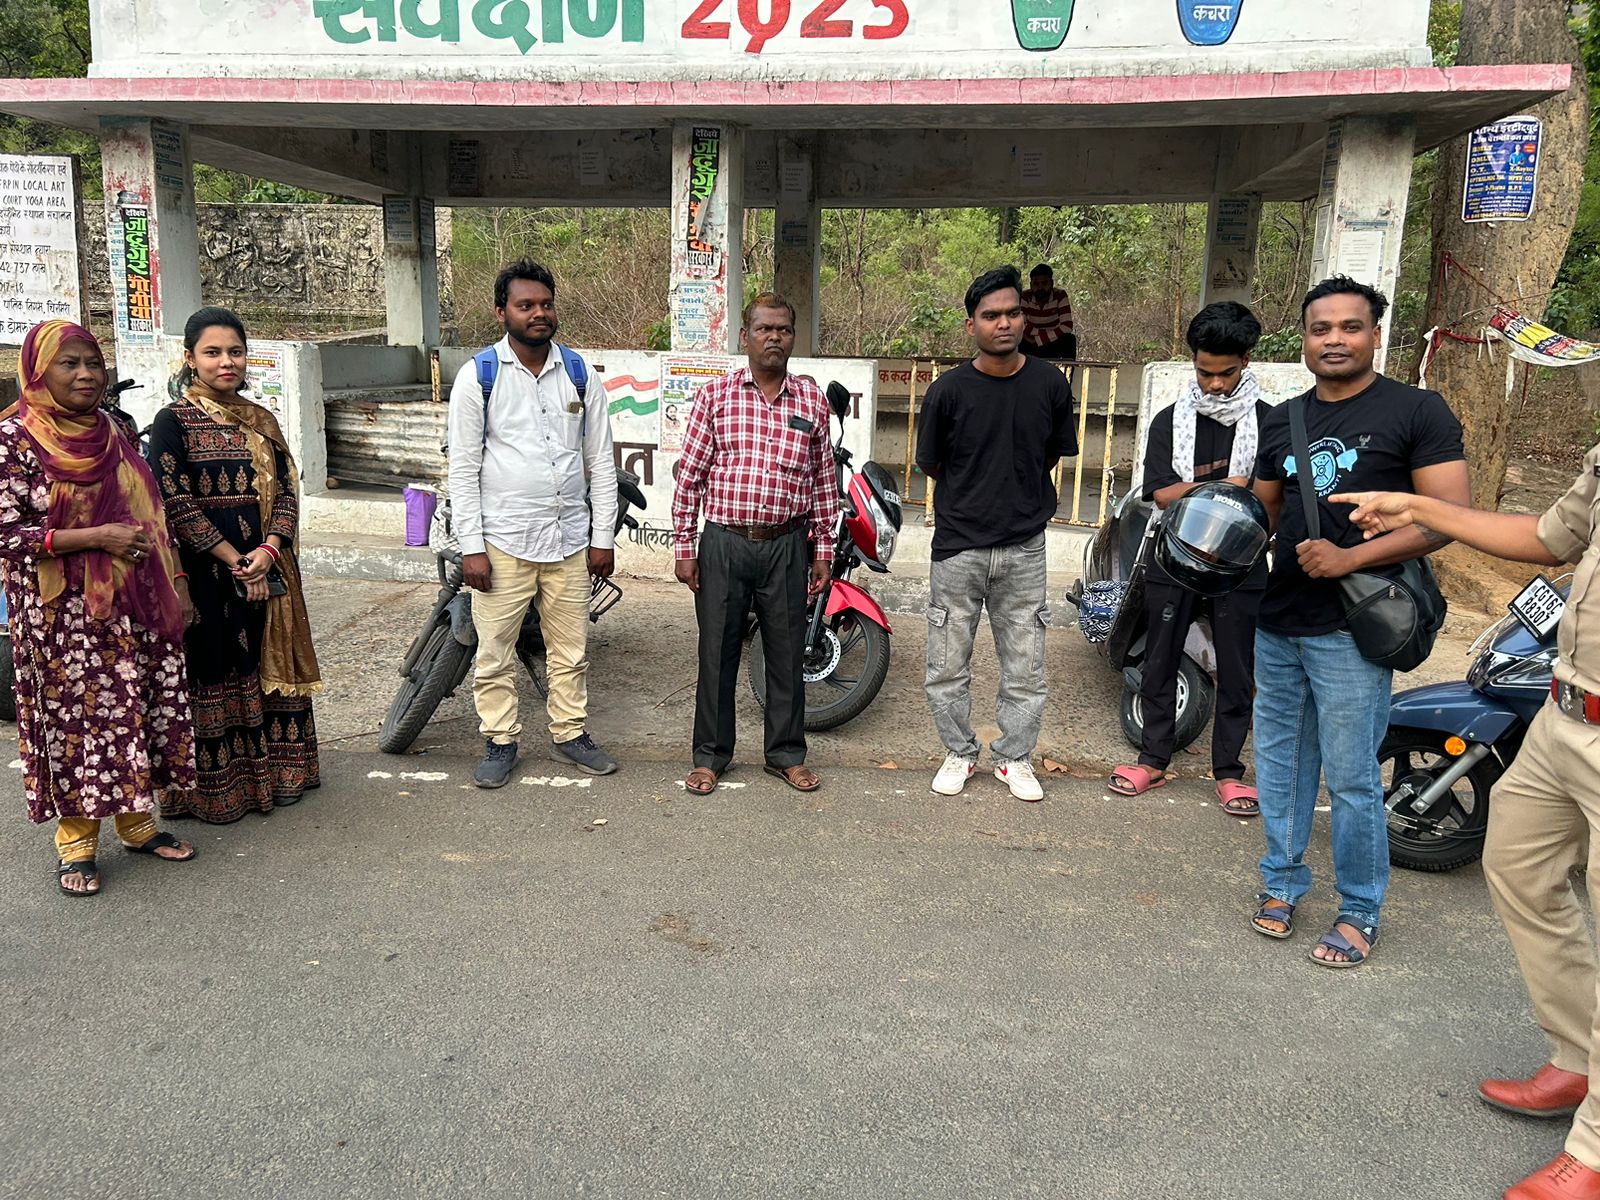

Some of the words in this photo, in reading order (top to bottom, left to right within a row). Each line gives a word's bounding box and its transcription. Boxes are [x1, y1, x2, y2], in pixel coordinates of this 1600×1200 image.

[1193, 5, 1232, 21] कचरा
[1027, 17, 1061, 33] कचरा
[23, 180, 48, 191] LOCAL
[51, 181, 66, 192] ART
[3, 194, 22, 206] COURT
[26, 195, 44, 207] YOGA
[47, 196, 66, 207] AREA
[125, 209, 146, 217] देखिये
[1533, 585, 1563, 615] CG16C
